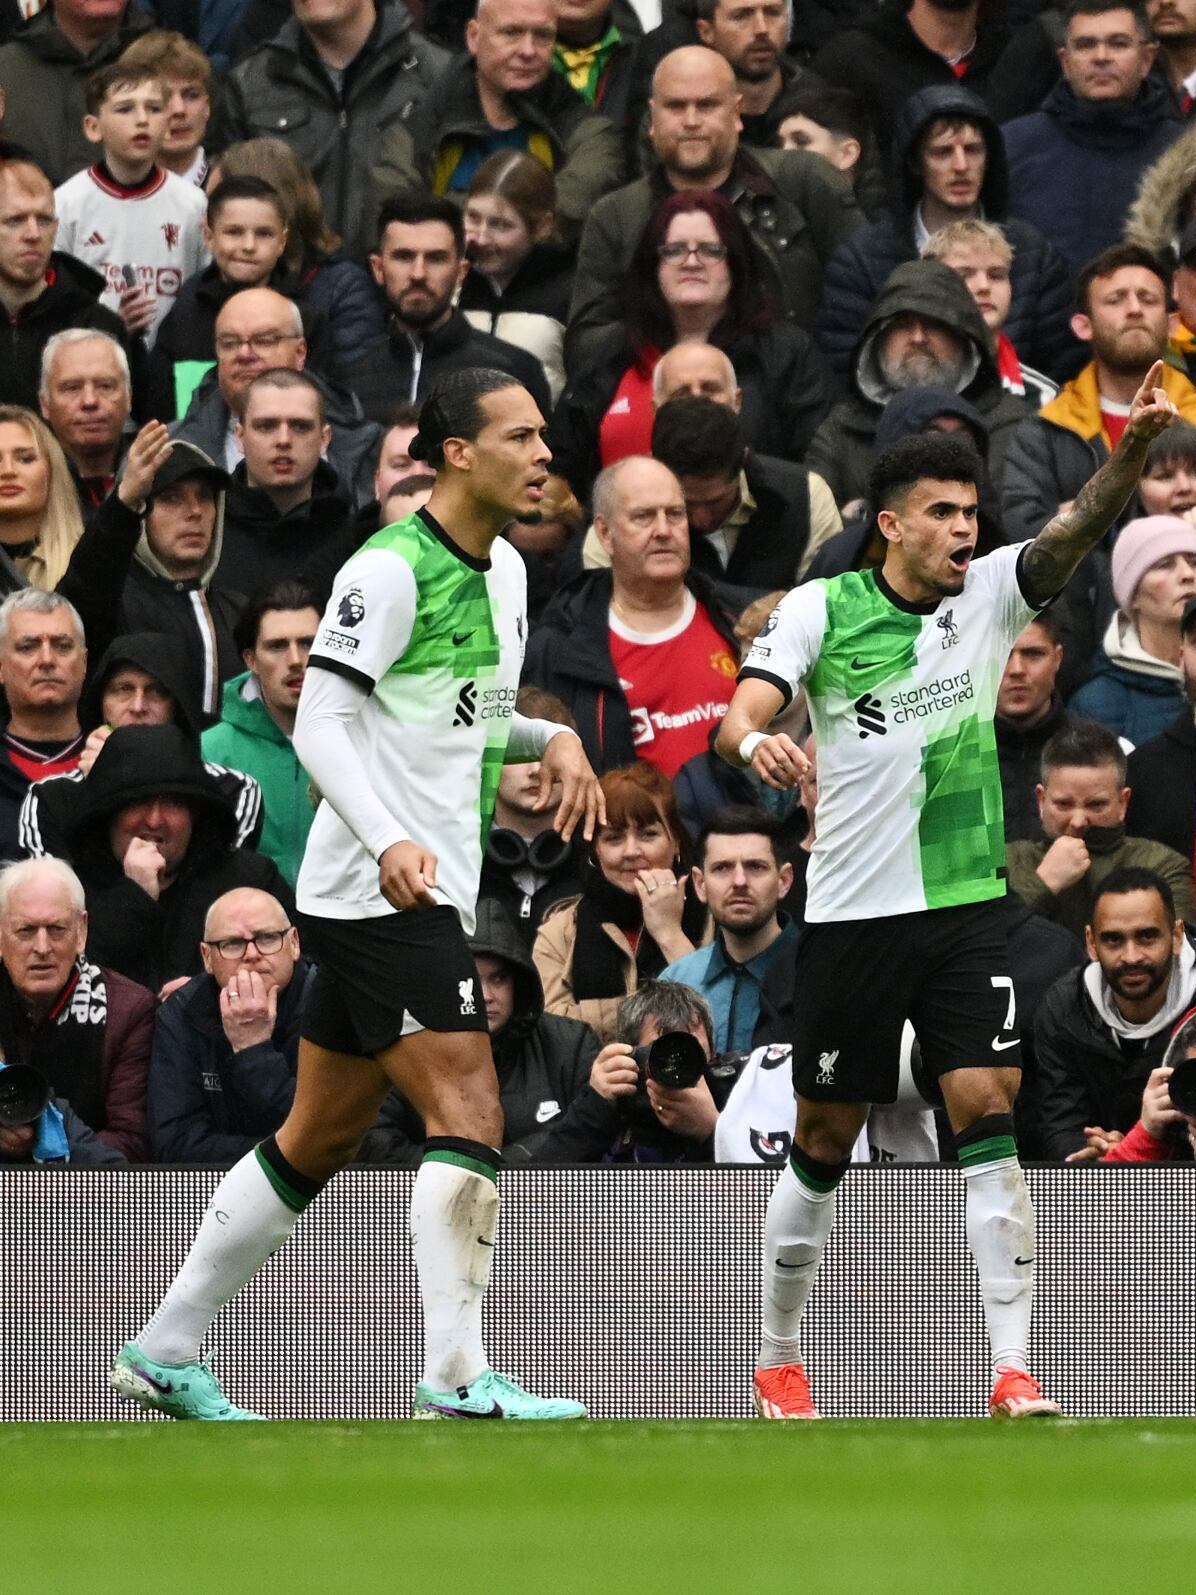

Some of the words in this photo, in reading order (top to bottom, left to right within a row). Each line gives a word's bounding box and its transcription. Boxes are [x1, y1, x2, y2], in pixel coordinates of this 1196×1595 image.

[99, 261, 154, 279] Tem
[941, 636, 960, 650] LFC
[890, 669, 971, 708] standard
[893, 683, 974, 724] chartered
[460, 1005, 477, 1015] LFC
[990, 976, 1016, 1030] 7
[816, 1076, 836, 1085] LFC
